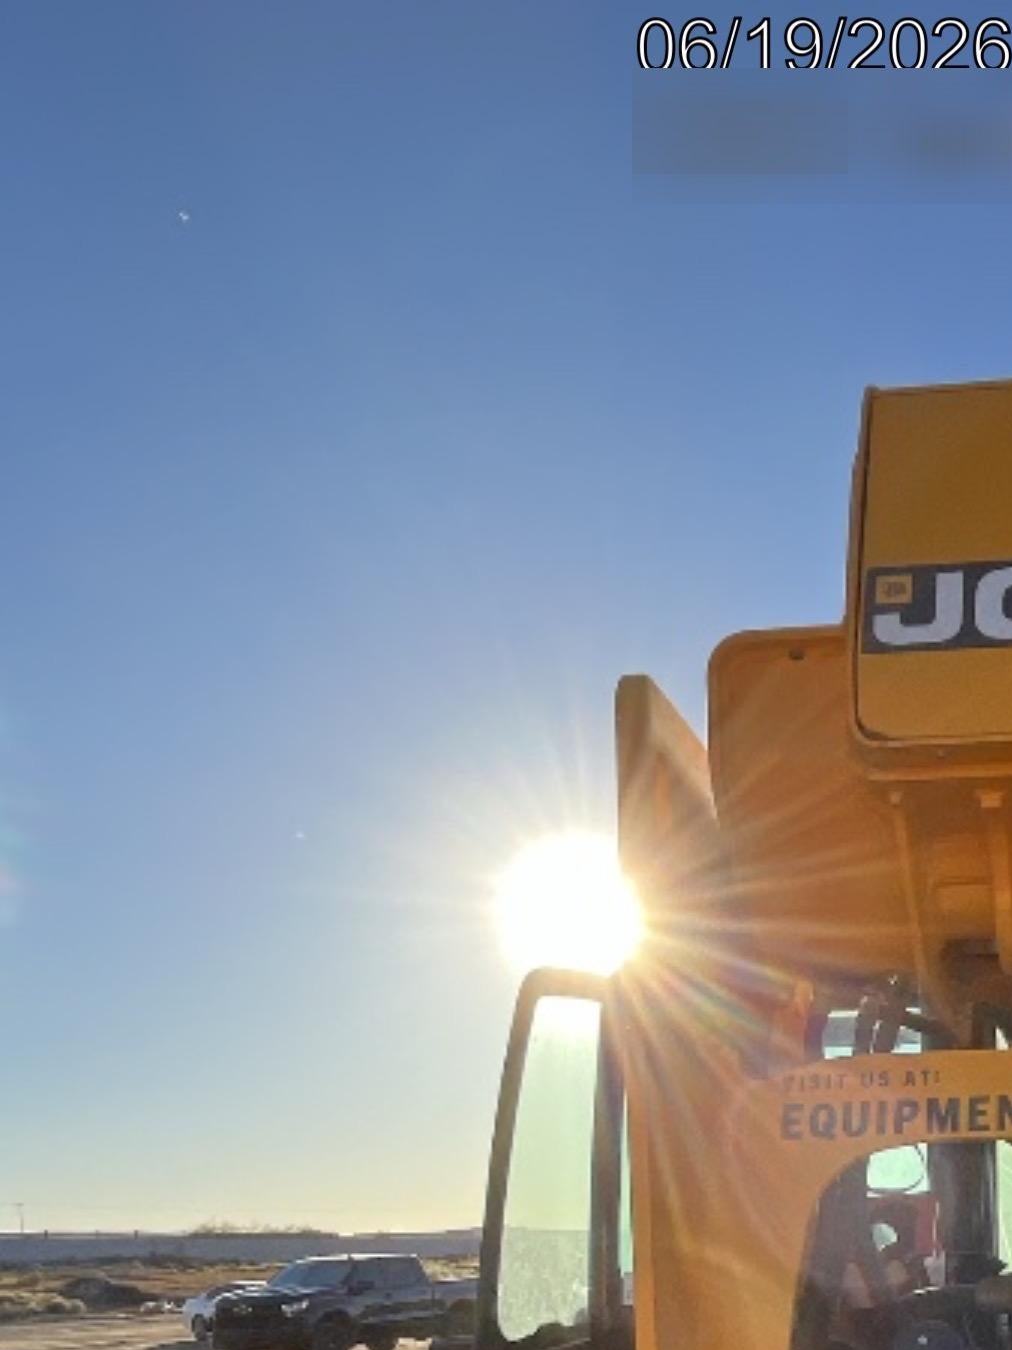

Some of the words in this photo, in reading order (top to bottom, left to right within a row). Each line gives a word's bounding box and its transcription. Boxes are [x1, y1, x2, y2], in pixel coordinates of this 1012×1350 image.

[783, 1073, 848, 1093] VISIT
[861, 1070, 890, 1088] US
[903, 1070, 940, 1087] AT:
